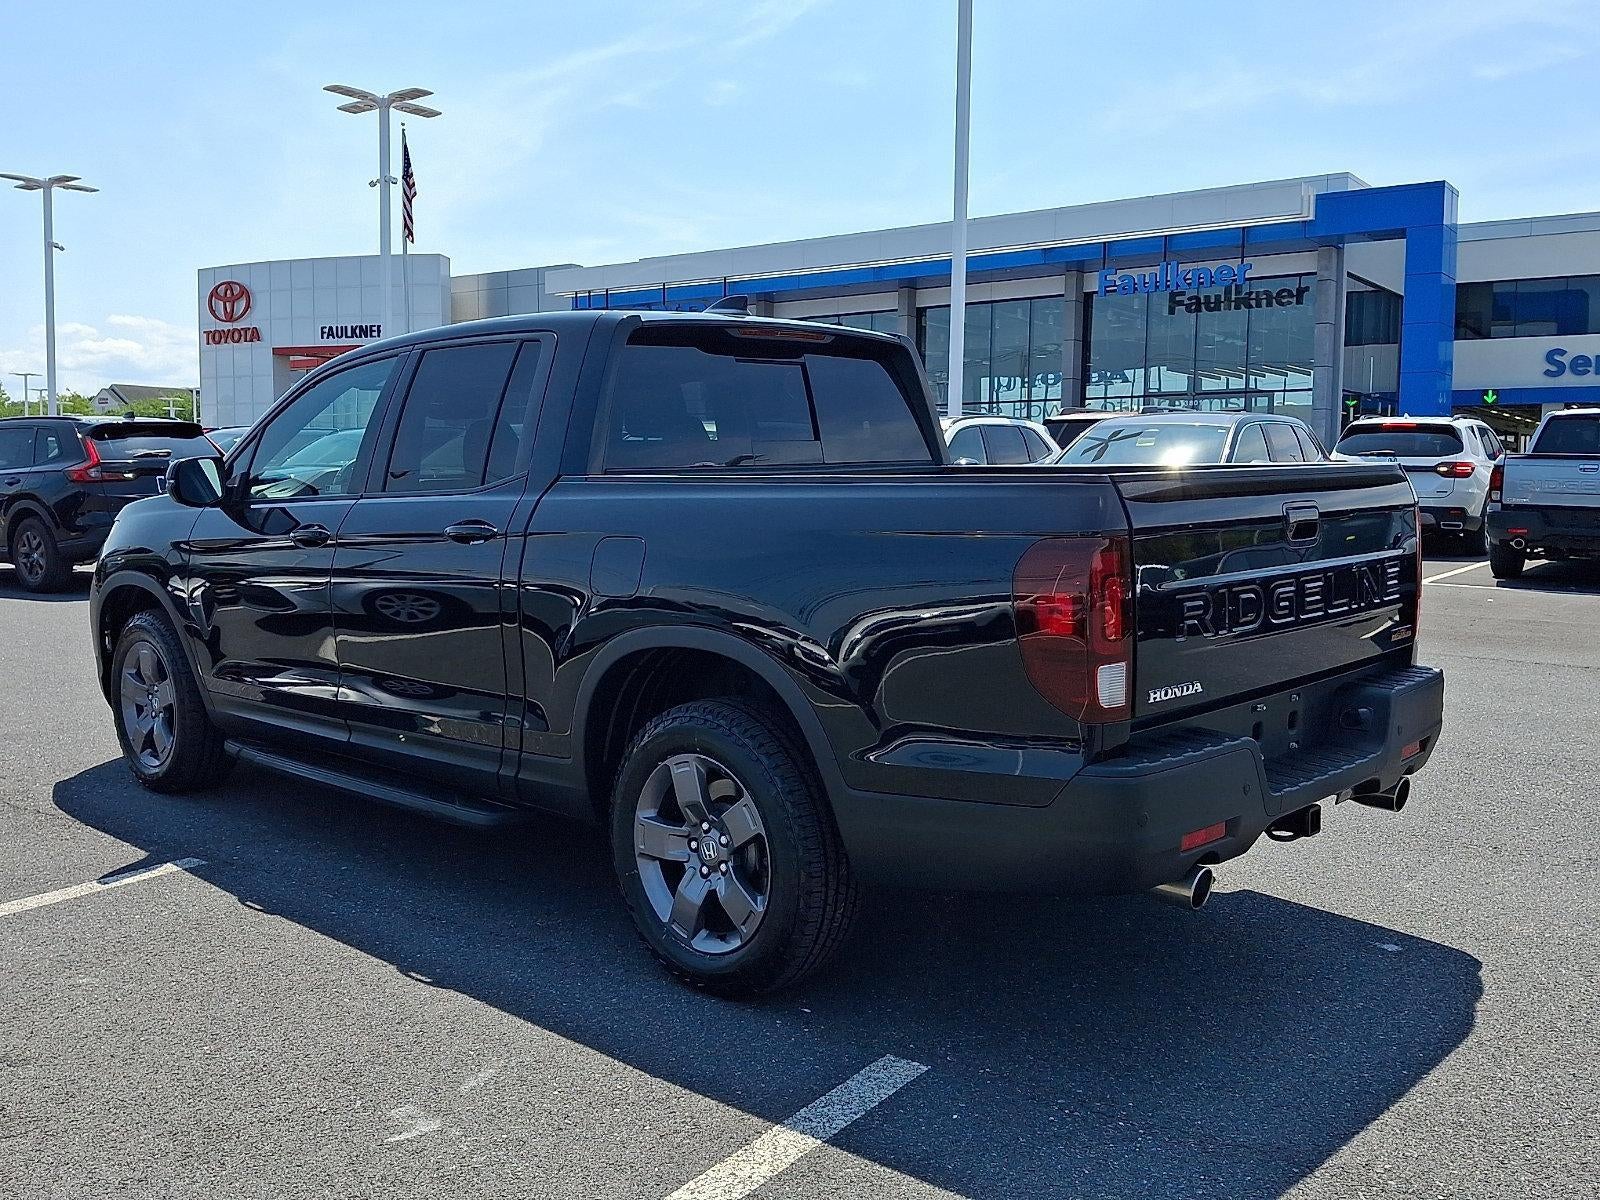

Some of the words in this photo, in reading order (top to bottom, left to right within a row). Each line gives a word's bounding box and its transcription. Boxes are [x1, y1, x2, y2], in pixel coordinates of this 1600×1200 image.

[1098, 260, 1253, 297] Faulkner
[1168, 283, 1311, 315] Faulkner
[203, 326, 261, 345] TOYOTA
[1175, 559, 1400, 642] RIDGELINE
[1148, 680, 1203, 704] HONDA
